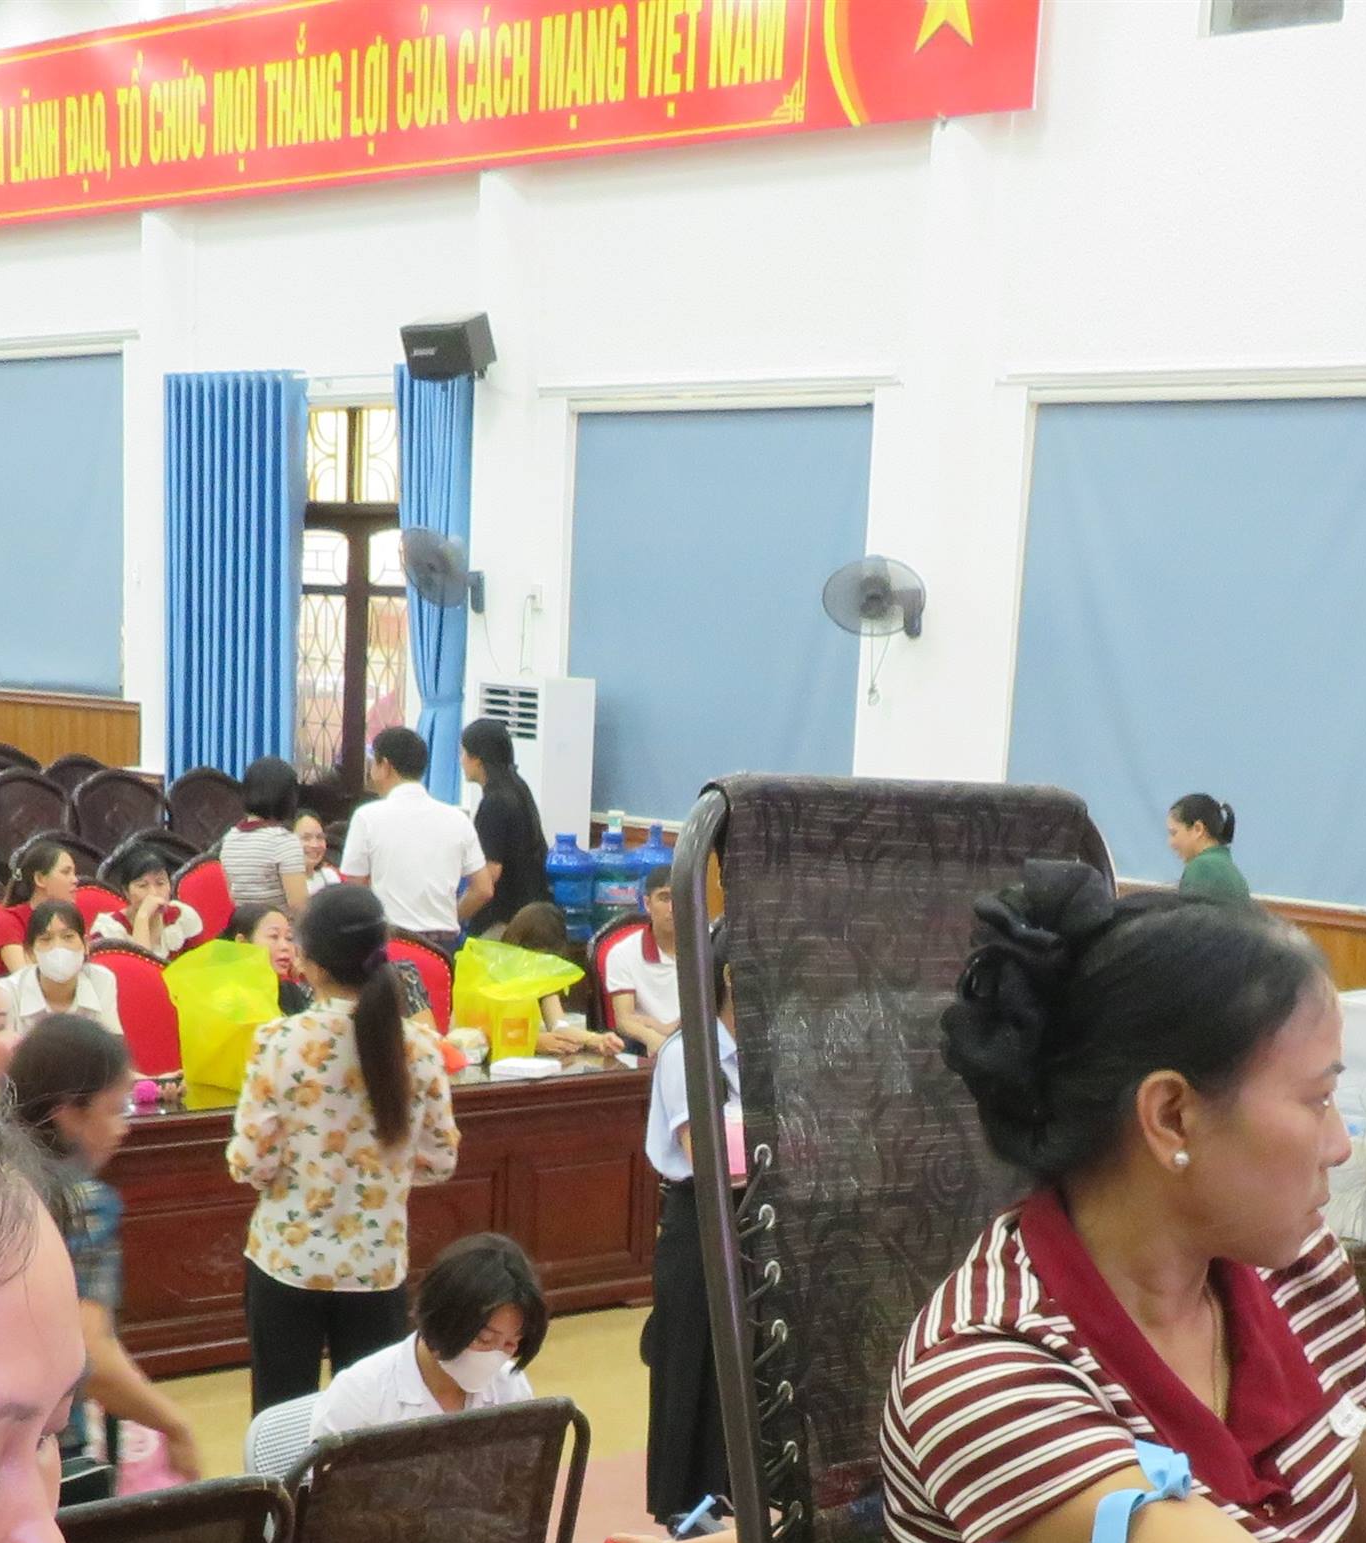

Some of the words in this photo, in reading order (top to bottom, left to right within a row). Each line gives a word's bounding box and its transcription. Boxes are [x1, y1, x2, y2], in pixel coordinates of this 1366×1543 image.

[9, 88, 60, 184] LÃNH
[65, 91, 112, 193] ĐẠO,
[116, 49, 143, 168] TỔ
[148, 58, 207, 165] CHỨC
[213, 65, 257, 173] MỌI
[263, 22, 343, 149] THẮNG
[349, 34, 389, 156] LỢI
[396, 4, 449, 131] CỦA
[456, 6, 532, 124] CÁCH
[538, 3, 628, 130] MẠNG
[708, 0, 786, 89] NAM
